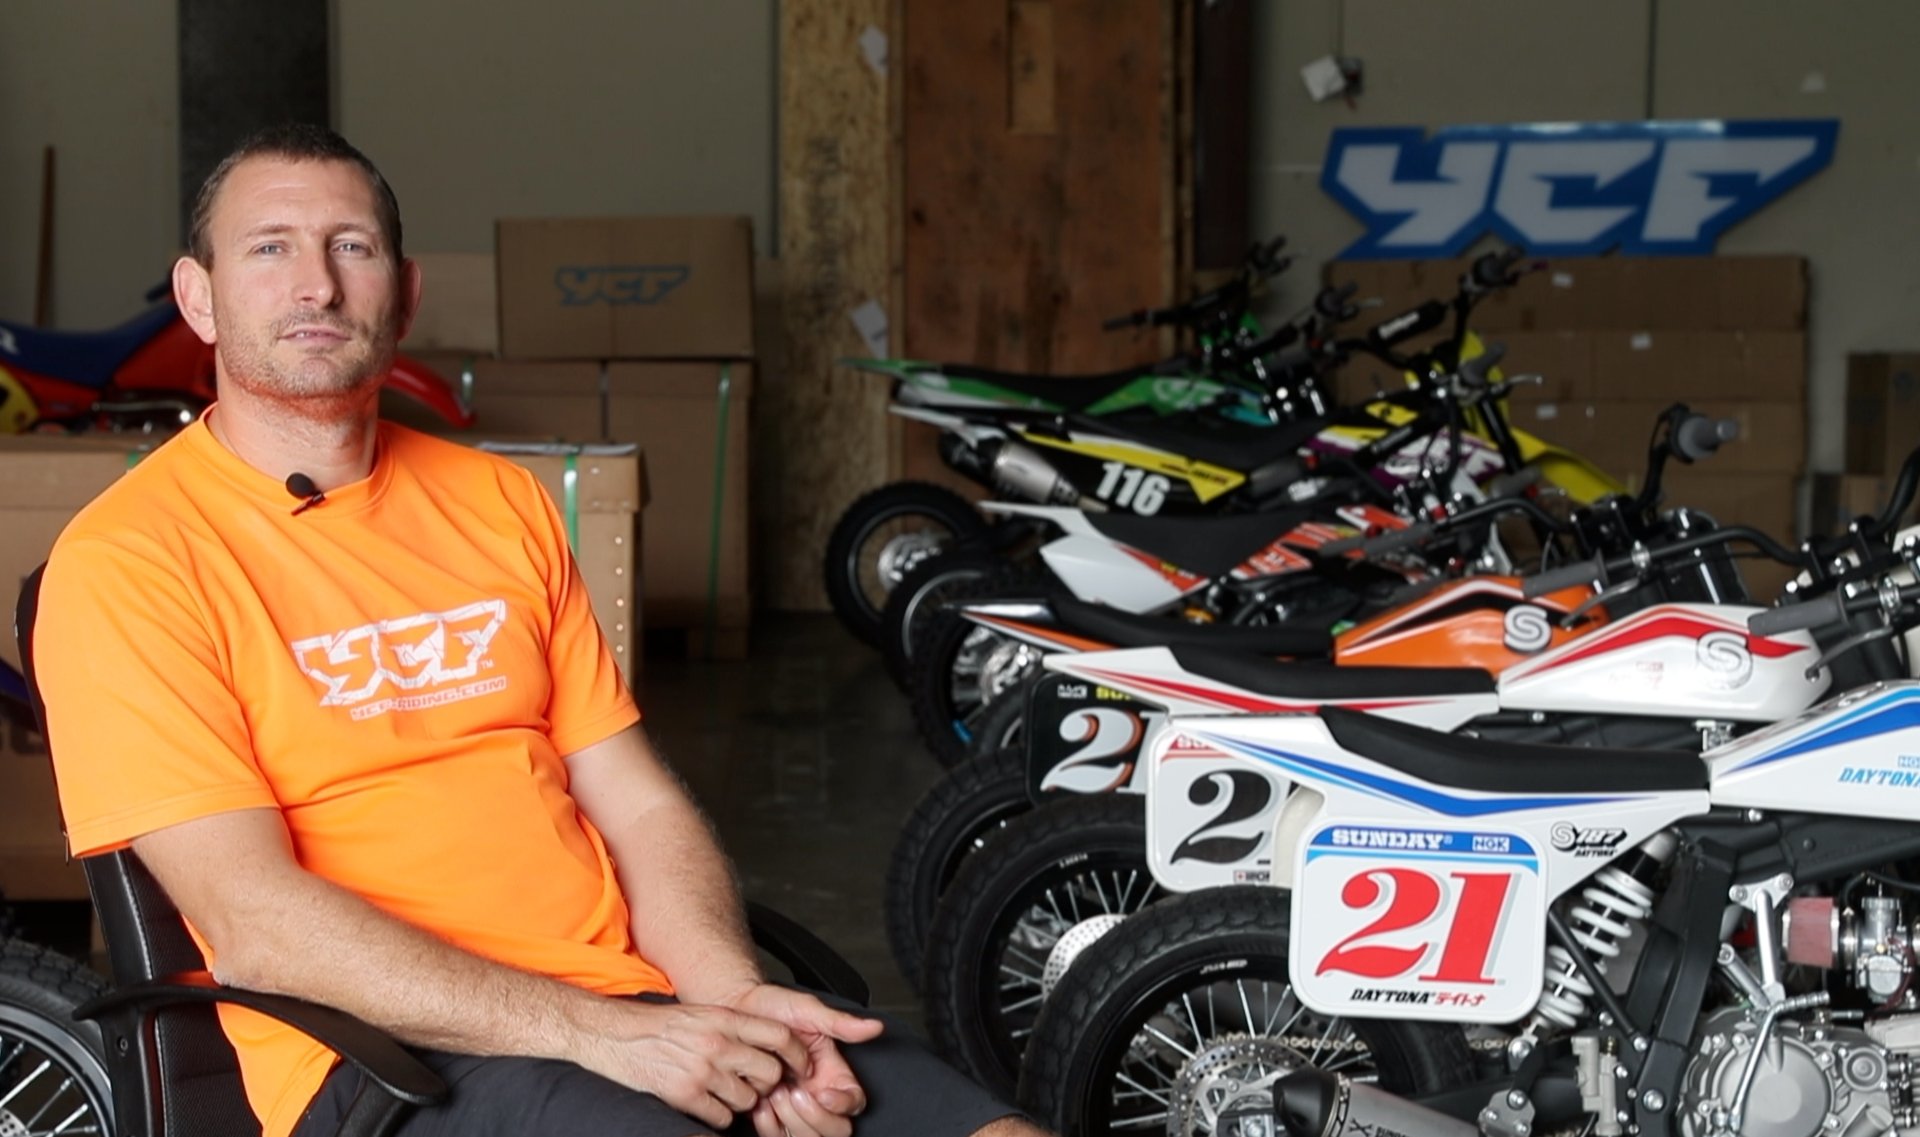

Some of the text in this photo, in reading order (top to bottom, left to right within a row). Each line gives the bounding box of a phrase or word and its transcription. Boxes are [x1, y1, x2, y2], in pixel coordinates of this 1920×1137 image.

[1332, 131, 1822, 250] YCF
[1096, 461, 1171, 517] 116
[1170, 769, 1273, 865] 2
[1315, 867, 1513, 985] 21
